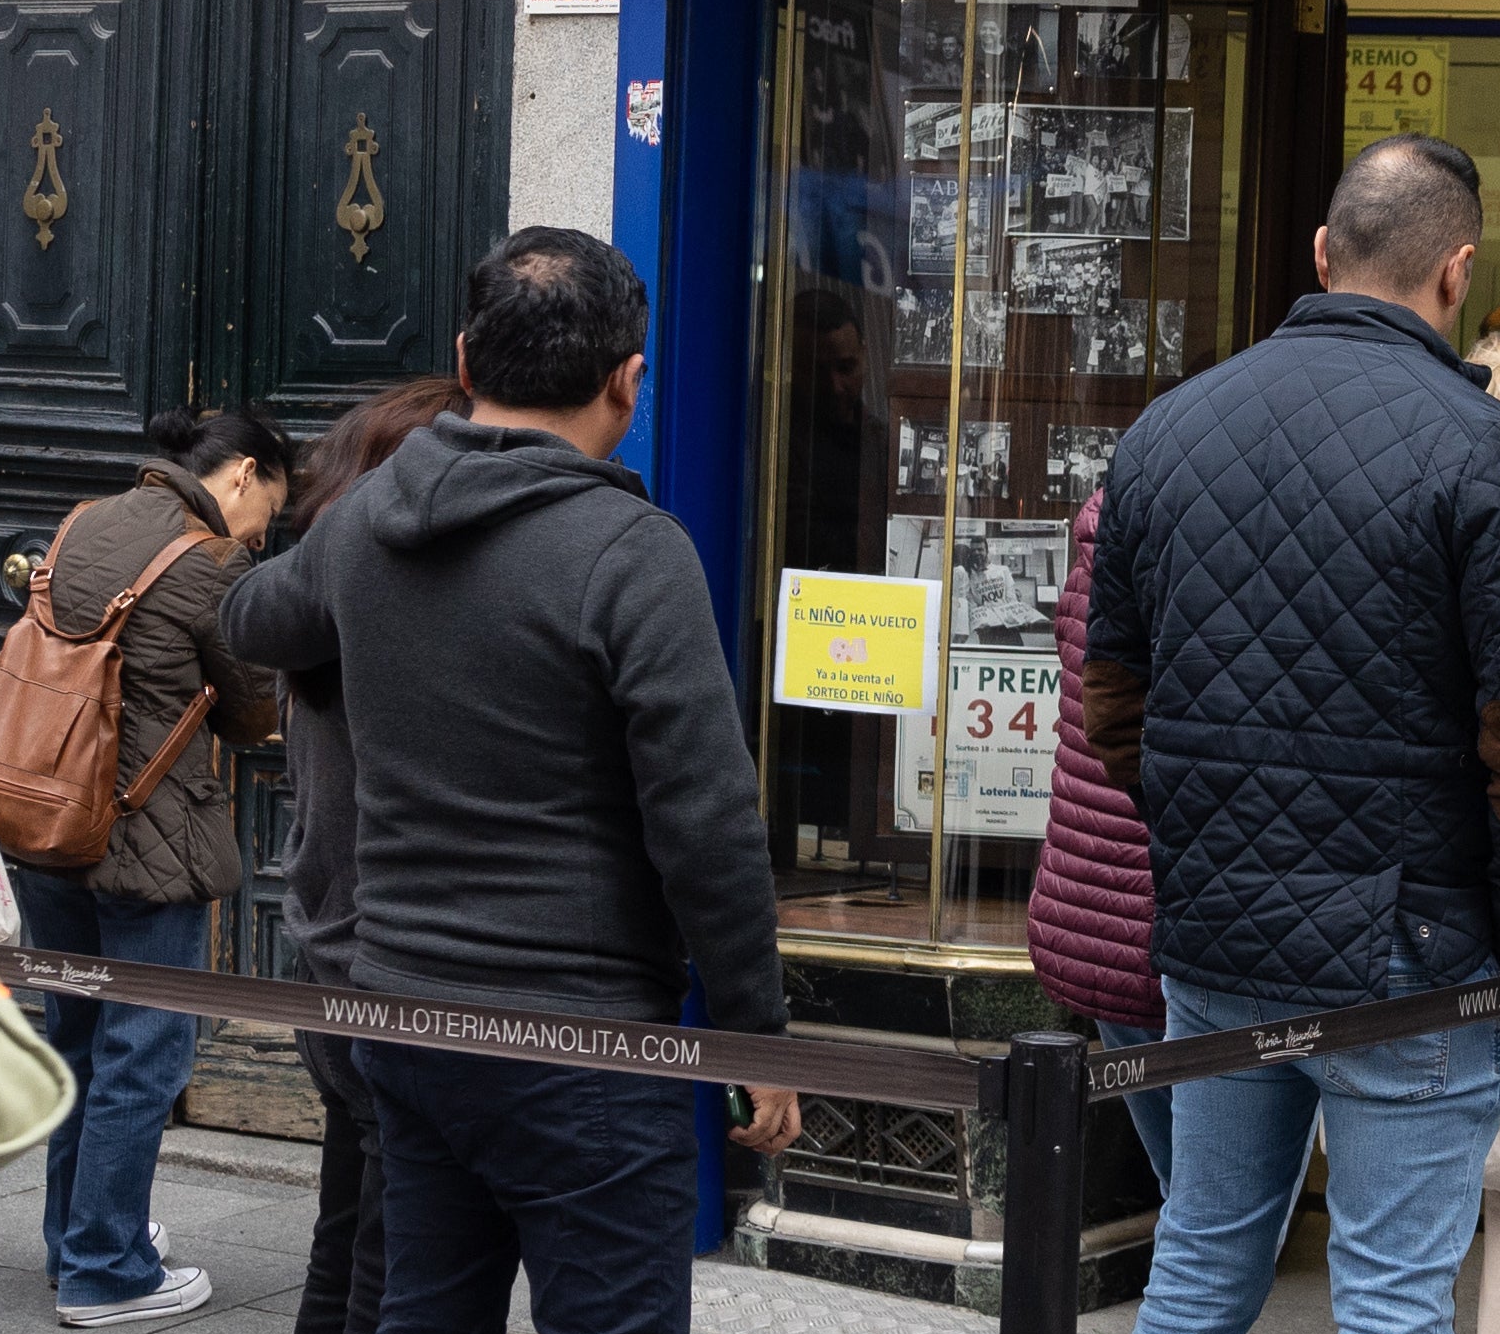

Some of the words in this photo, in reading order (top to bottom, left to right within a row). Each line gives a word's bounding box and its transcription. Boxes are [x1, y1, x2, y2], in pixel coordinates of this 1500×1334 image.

[1343, 70, 1432, 97] 440
[793, 607, 806, 621] EL
[808, 605, 847, 625] NIÑO
[849, 613, 867, 626] HA
[870, 614, 918, 630] VUELTO
[816, 668, 828, 680] Ya
[830, 673, 837, 681] a
[839, 670, 849, 682] la
[851, 673, 882, 685] venta
[884, 674, 895, 686] el
[806, 685, 848, 701] SORTEO
[851, 690, 870, 702] DEL
[873, 689, 904, 704] NIÑO
[322, 994, 700, 1067] WWW.LOTERIAMANOLITA.COM
